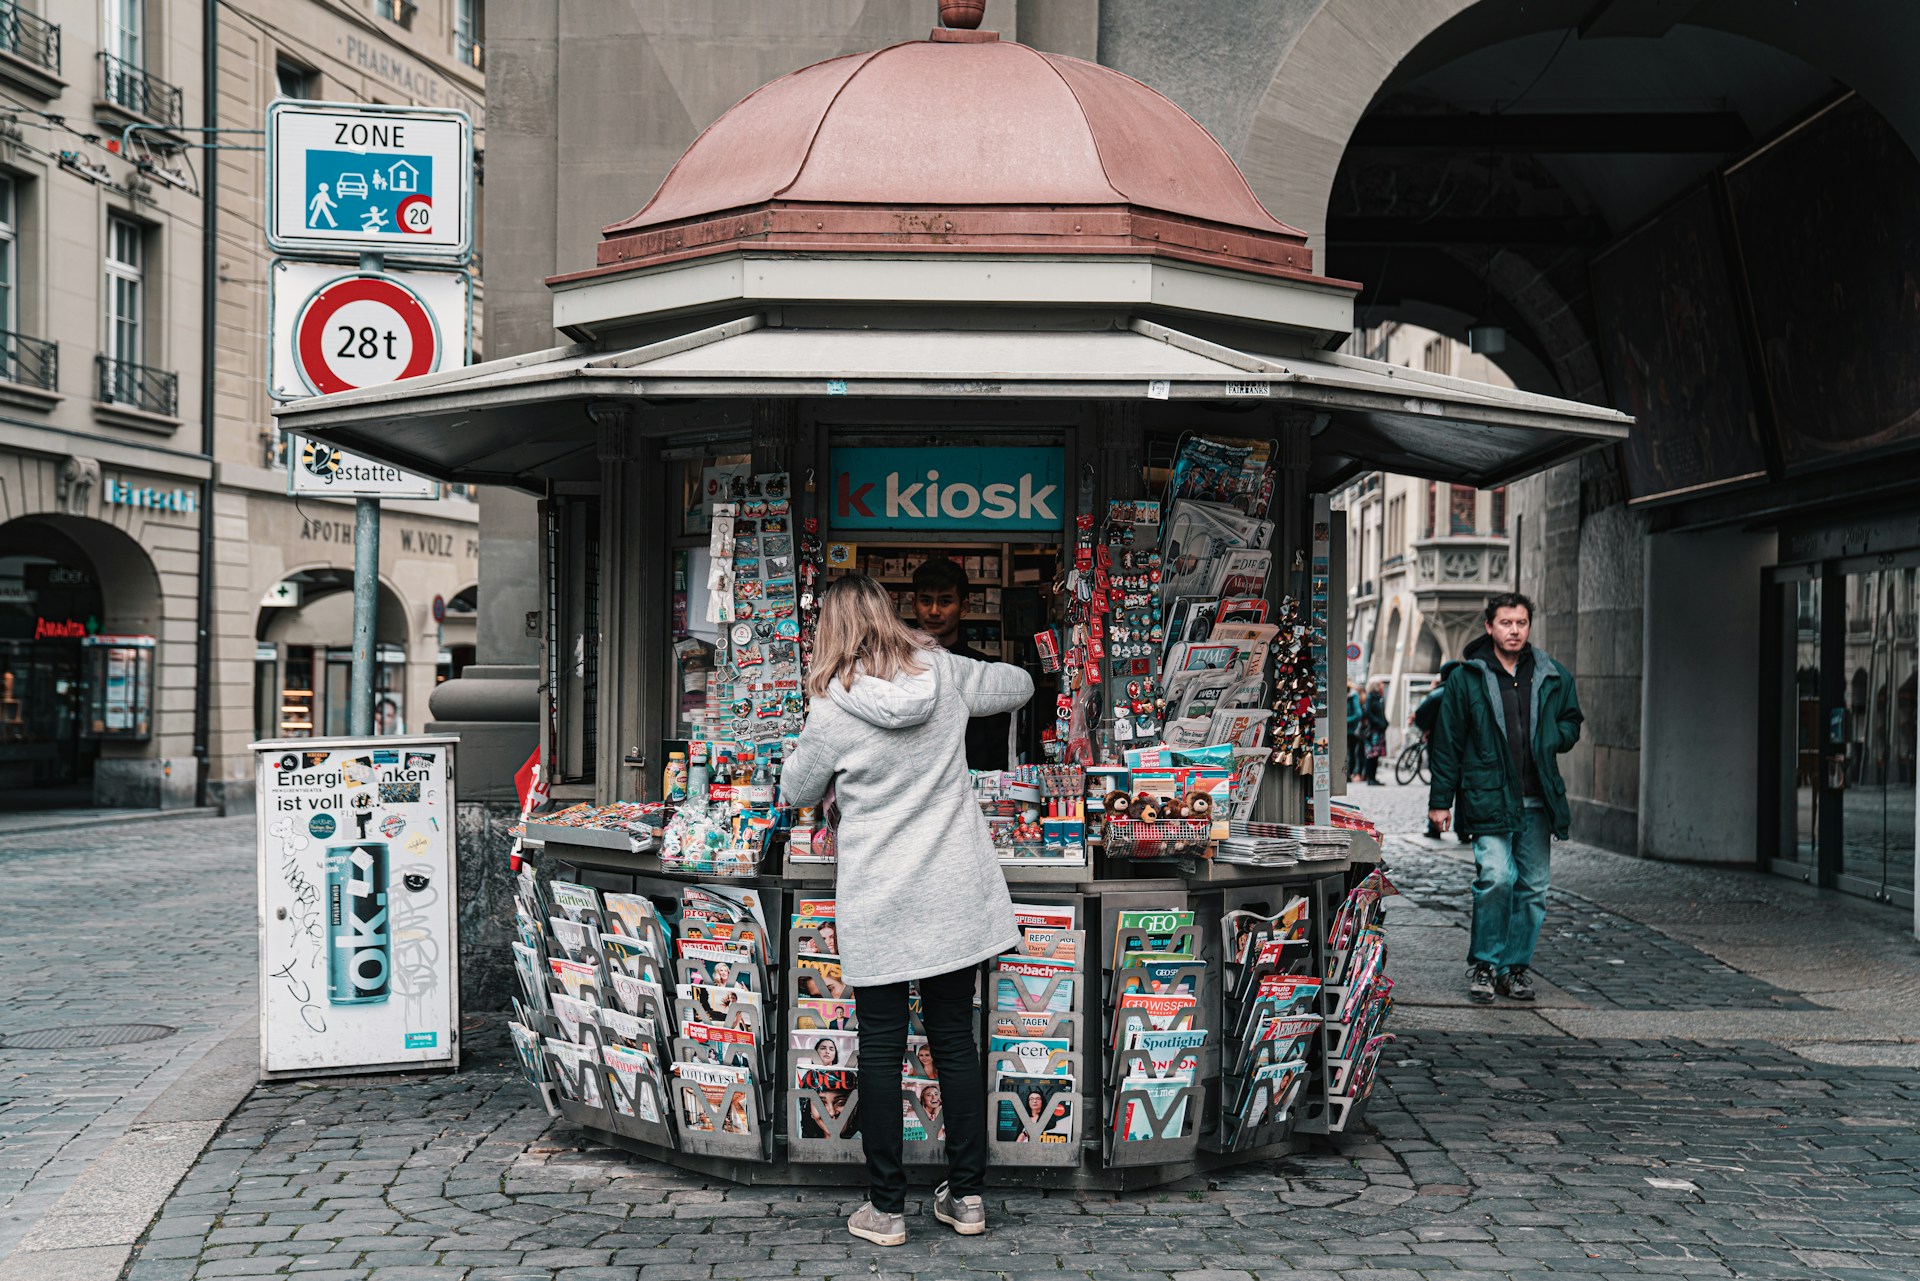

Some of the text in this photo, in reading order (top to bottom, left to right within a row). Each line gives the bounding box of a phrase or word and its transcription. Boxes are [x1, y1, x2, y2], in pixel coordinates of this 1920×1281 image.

[334, 123, 405, 148] ZONE
[409, 208, 429, 225] 20
[836, 469, 1059, 520] k kiosk
[301, 518, 357, 543] APOTH
[1196, 649, 1229, 663] TIME
[1140, 761, 1160, 769] Swiss
[278, 795, 302, 811] ist
[308, 794, 343, 810] voll
[1138, 915, 1177, 932] GEO
[682, 942, 725, 952] DETECTIVE
[1149, 1000, 1193, 1011] WISSEN
[1142, 1036, 1203, 1051] Spotlight
